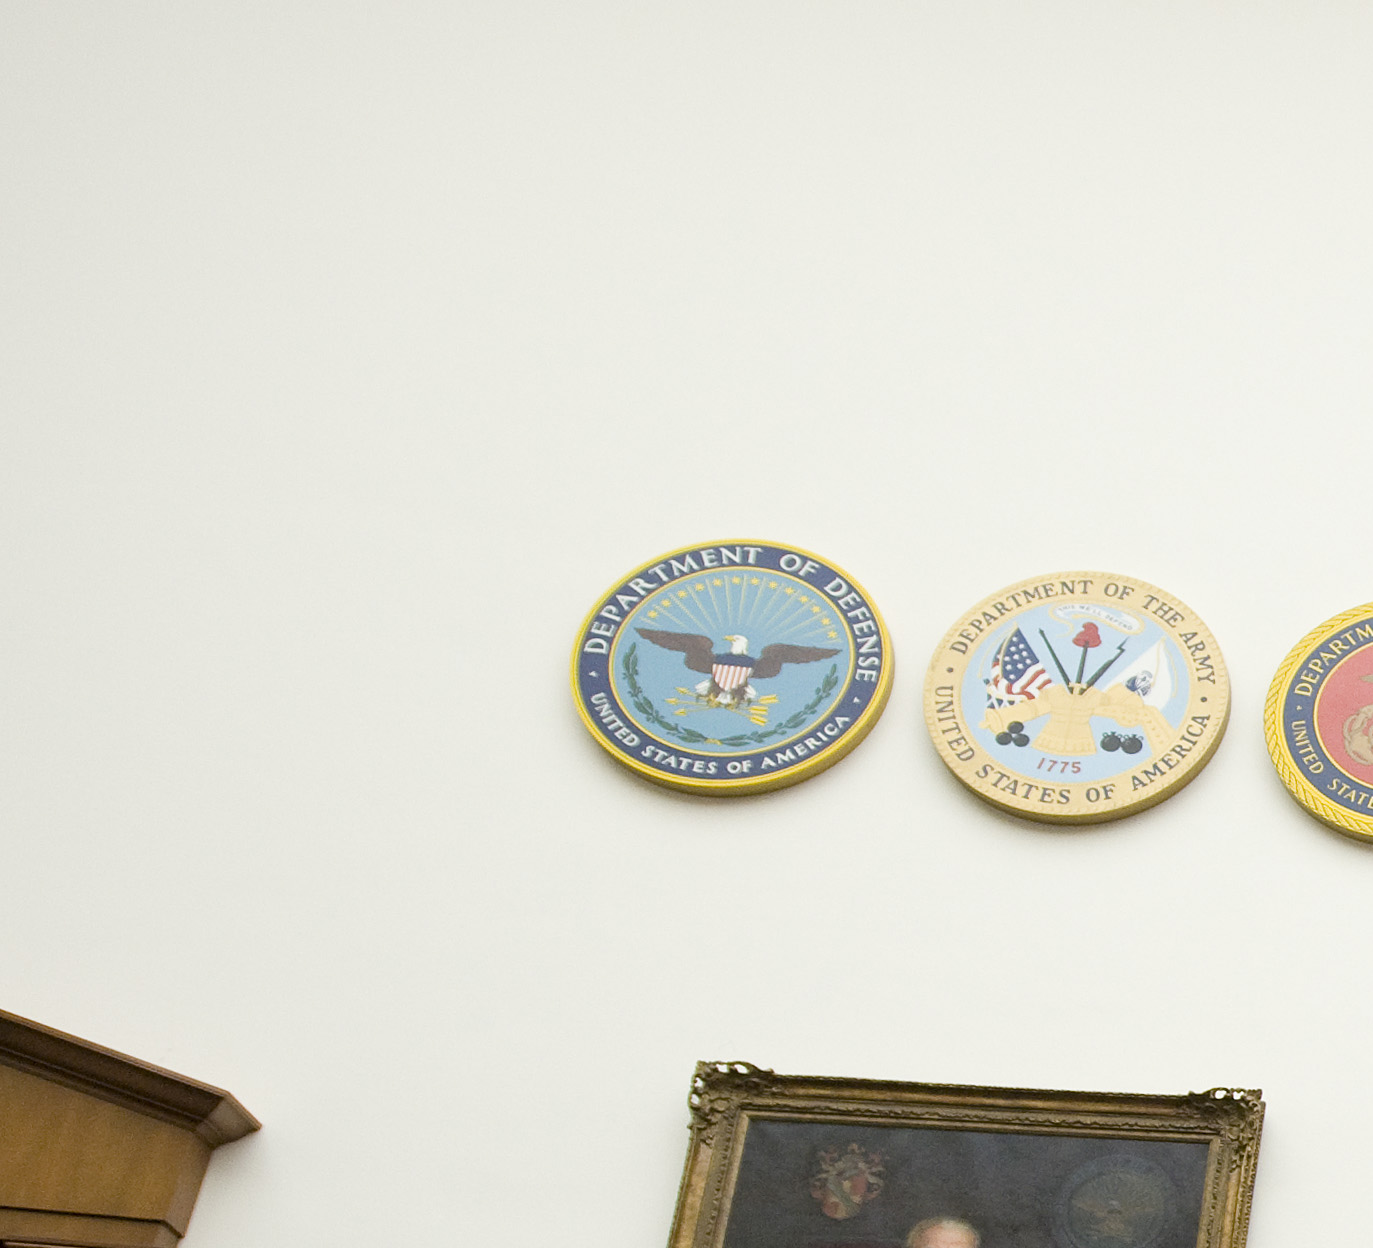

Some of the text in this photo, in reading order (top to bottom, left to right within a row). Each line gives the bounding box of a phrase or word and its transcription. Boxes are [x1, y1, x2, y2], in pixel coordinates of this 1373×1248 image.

[583, 546, 880, 683] DEPARTMENT OF DEFENSE
[951, 580, 1216, 685] DEPARTMENT OF THE ARMY
[590, 692, 850, 775] UNITED STATES OF AMERICA
[935, 684, 1211, 805] UNITED STATES OF AMERICA
[1037, 757, 1082, 774] 1775
[1291, 719, 1324, 775] UNITED
